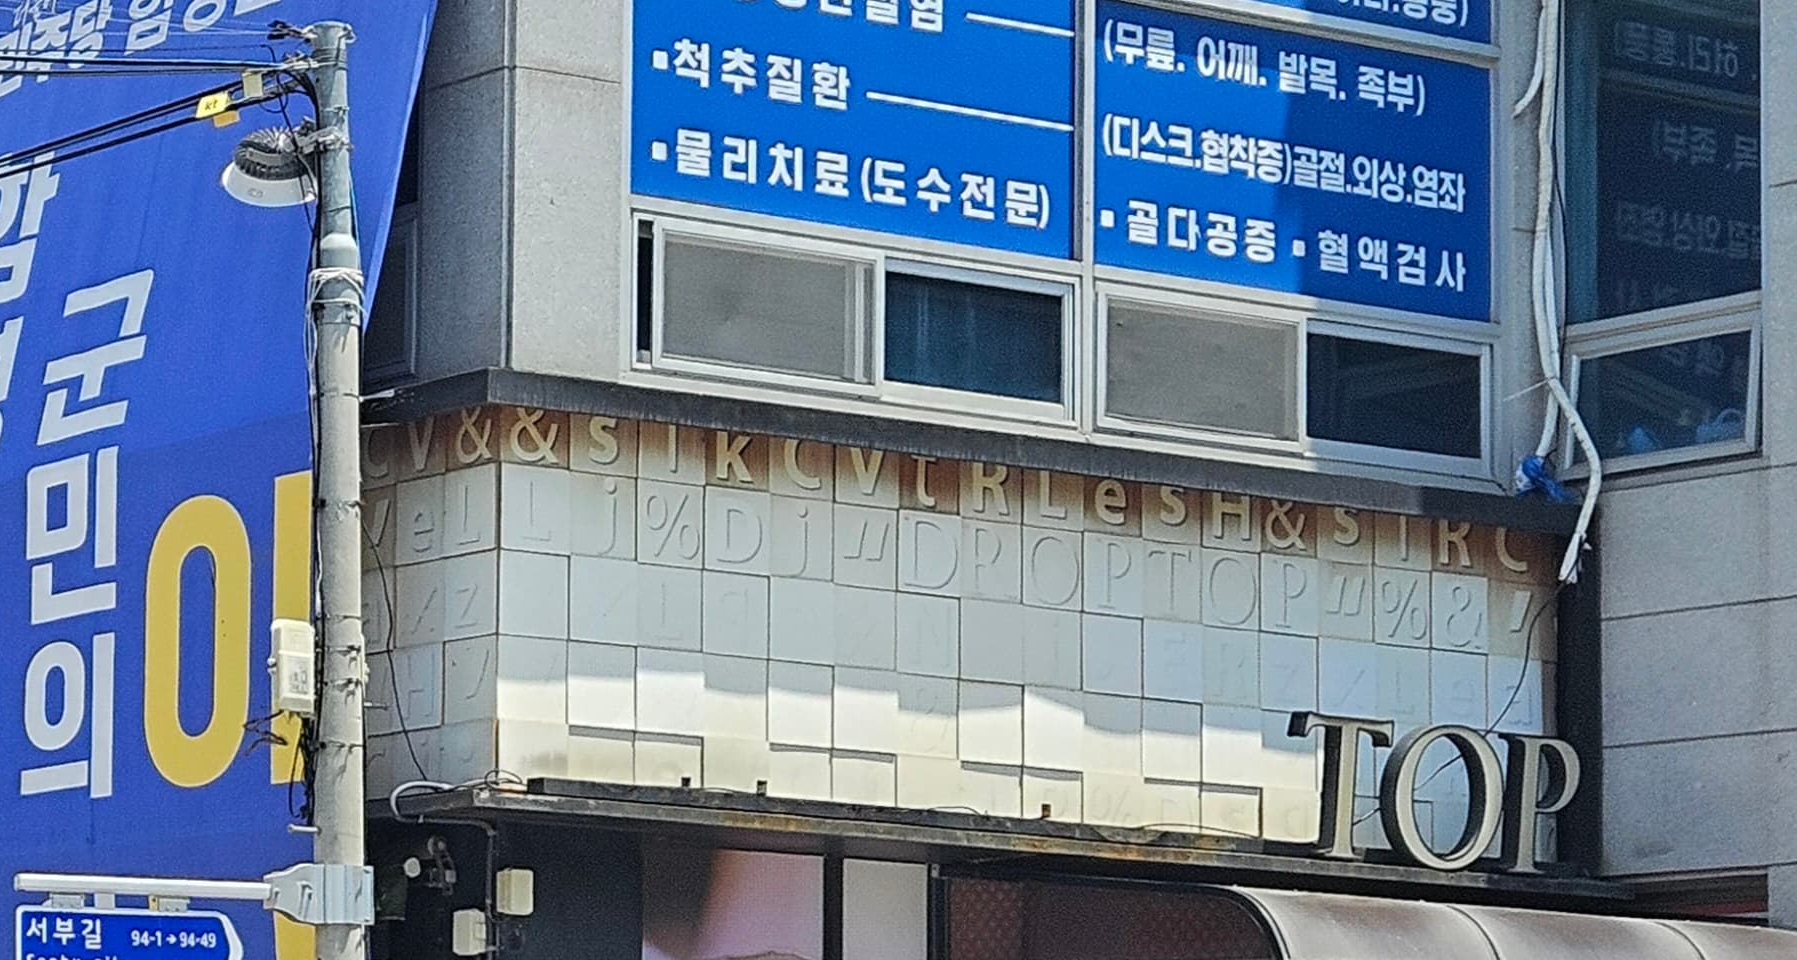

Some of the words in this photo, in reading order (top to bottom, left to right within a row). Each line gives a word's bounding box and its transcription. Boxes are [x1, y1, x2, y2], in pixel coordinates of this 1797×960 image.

[672, 38, 851, 111] 척추질환
[1104, 19, 1185, 73] (무릎.
[1196, 37, 1268, 87] 어깨.
[1278, 51, 1347, 101] 발목.
[1357, 65, 1427, 117] 족부)
[676, 128, 1050, 230] 물리치료(도수전문)
[1127, 200, 1277, 264] 골다공증
[1318, 230, 1467, 292] 혈액검사
[20, 268, 154, 799] 군민의
[1287, 711, 1582, 874] TOP
[26, 918, 103, 950] 서부길
[130, 929, 162, 947] 94-1
[179, 930, 217, 948] 94-49
